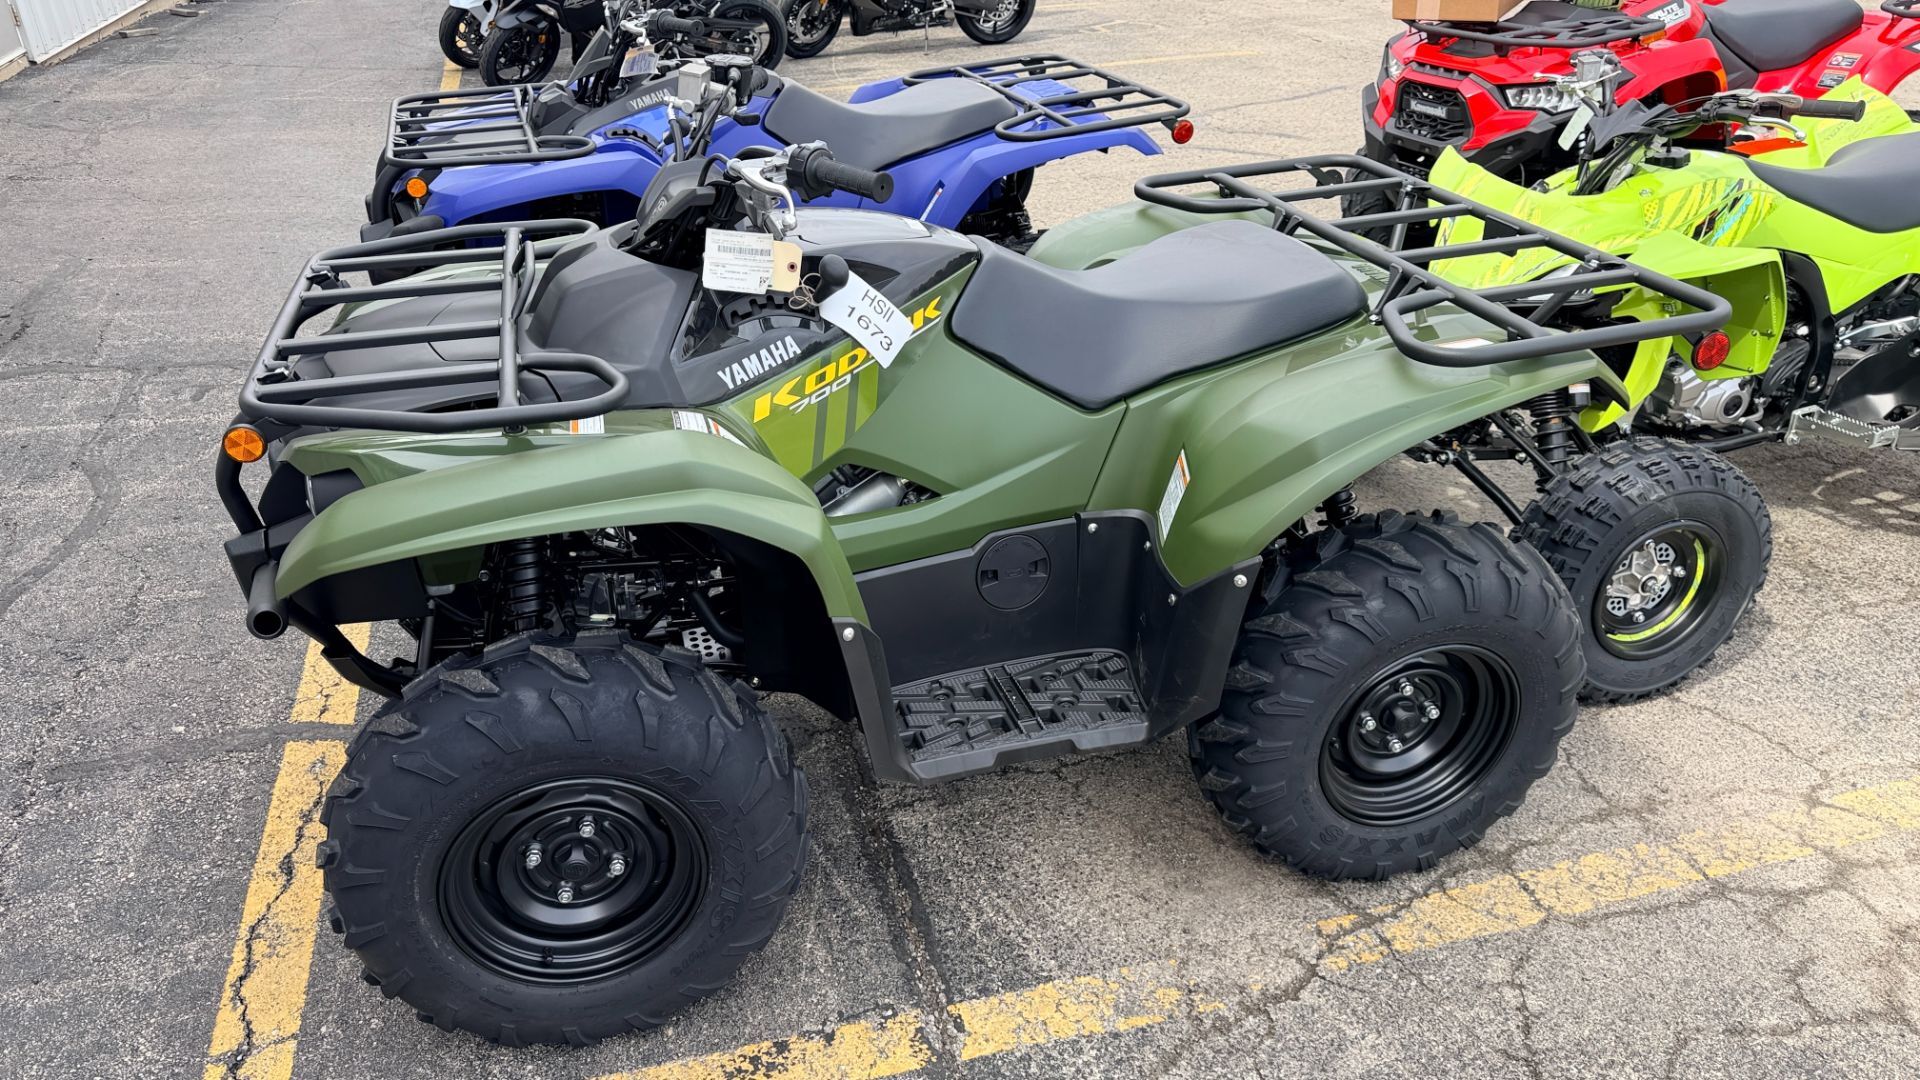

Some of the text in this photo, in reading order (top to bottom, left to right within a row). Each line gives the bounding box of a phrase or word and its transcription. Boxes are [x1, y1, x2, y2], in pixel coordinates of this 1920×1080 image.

[1660, 8, 1686, 24] ORCE
[629, 88, 672, 110] YAMAHA
[847, 304, 893, 352] 1673
[861, 289, 895, 323] HSII
[717, 335, 801, 390] YAMAHA
[753, 295, 942, 424] KODK
[789, 373, 852, 415] 700
[640, 766, 746, 930] MAXXIS
[1318, 796, 1486, 856] MAXXIS
